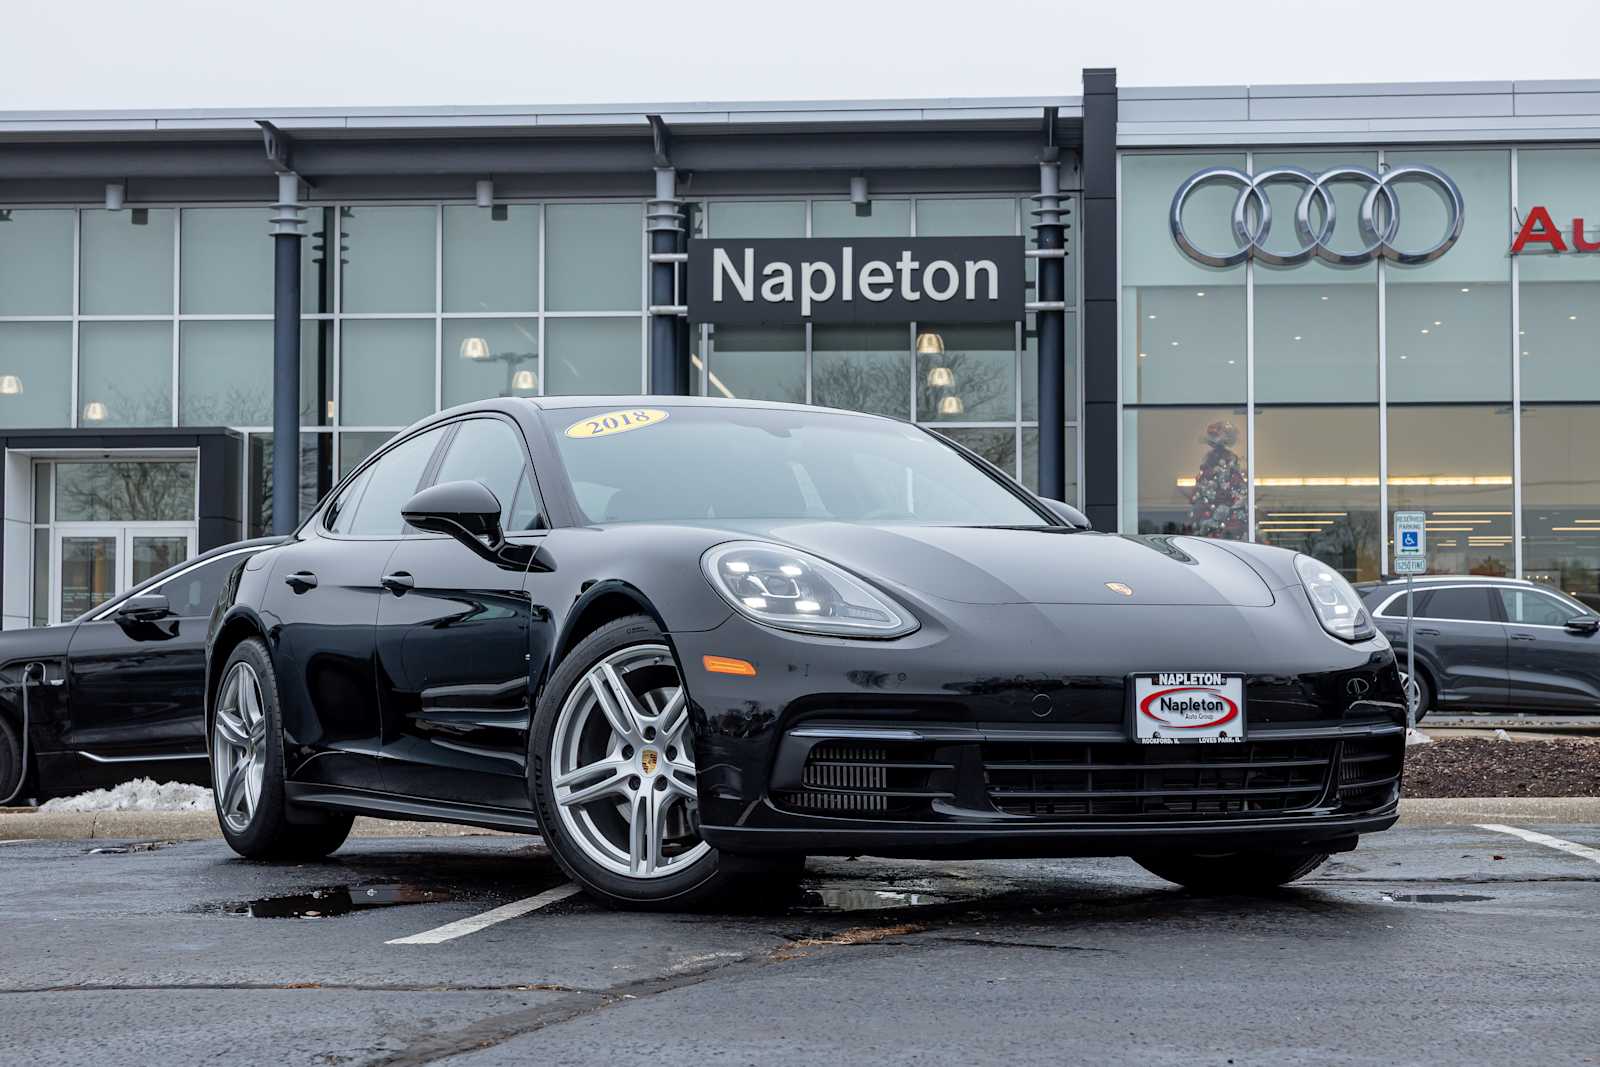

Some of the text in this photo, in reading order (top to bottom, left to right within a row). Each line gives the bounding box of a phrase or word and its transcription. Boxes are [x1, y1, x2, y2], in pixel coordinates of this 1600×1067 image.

[712, 246, 999, 317] Napleton
[586, 411, 651, 434] 2018
[1159, 673, 1222, 685] NAPLETON
[1160, 697, 1224, 715] Napleton
[1200, 713, 1214, 721] Group
[1198, 736, 1218, 744] LOVES
